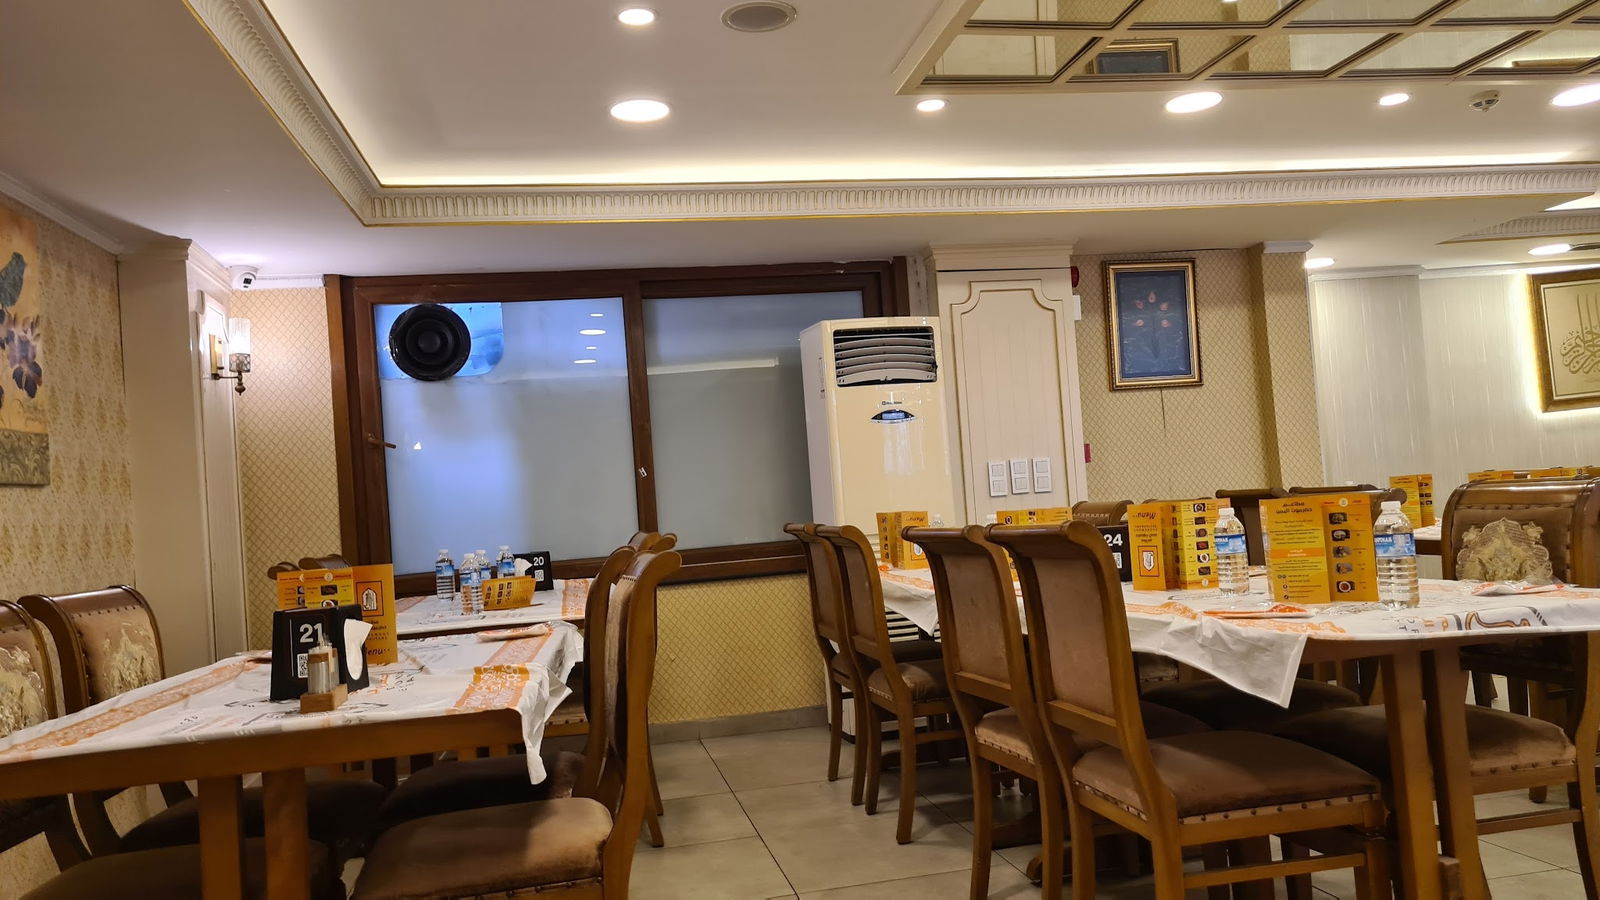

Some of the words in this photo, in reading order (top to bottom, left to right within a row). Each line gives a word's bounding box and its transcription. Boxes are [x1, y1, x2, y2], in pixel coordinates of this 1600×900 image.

[1103, 533, 1123, 547] 24
[533, 556, 544, 566] 20
[299, 622, 323, 643] 21
